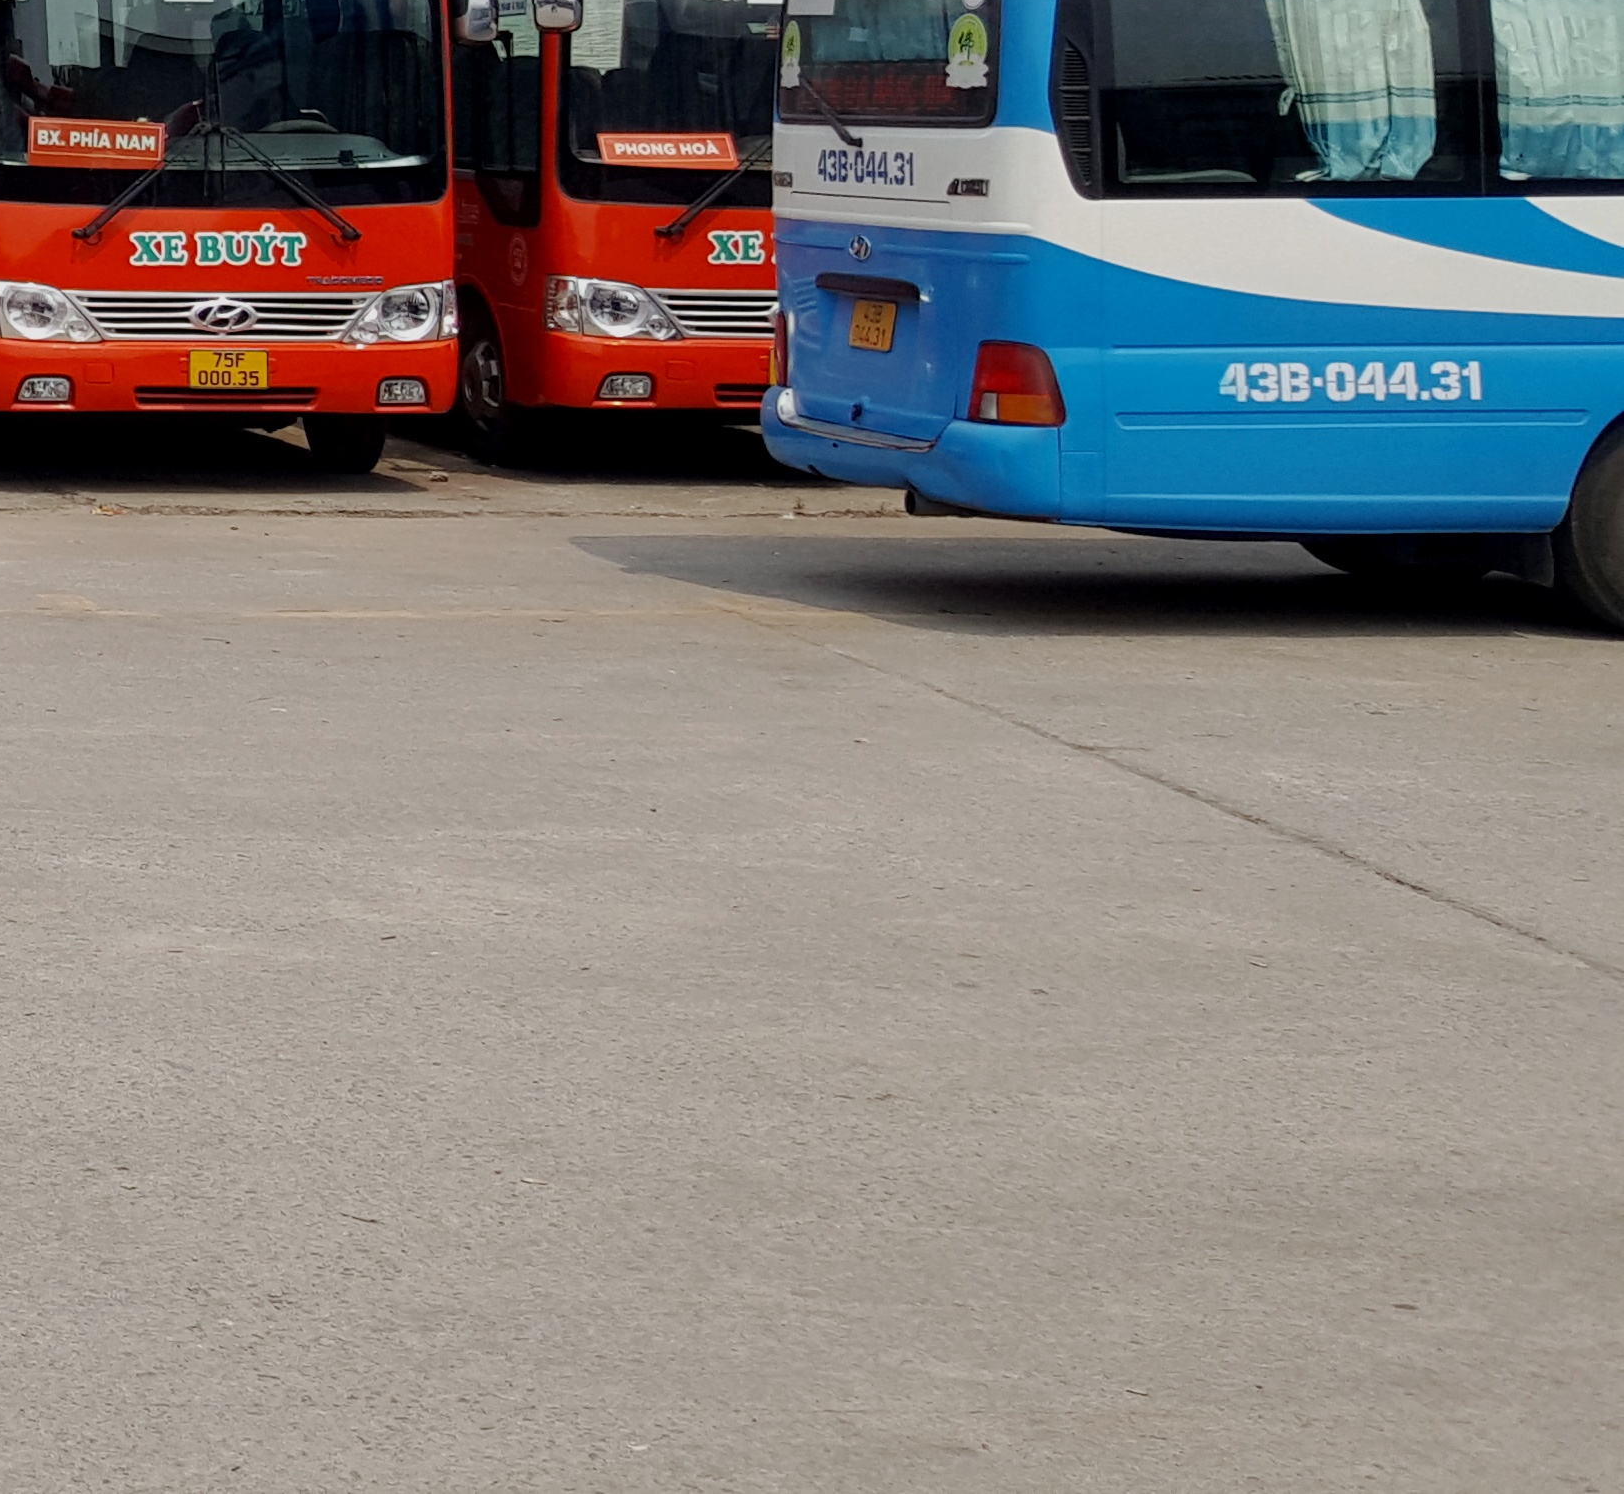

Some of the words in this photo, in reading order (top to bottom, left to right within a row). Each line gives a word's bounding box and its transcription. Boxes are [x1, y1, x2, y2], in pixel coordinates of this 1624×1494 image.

[37, 129, 66, 146] BX.
[69, 128, 111, 149] PHÍA
[115, 134, 156, 151] NAM
[614, 142, 677, 156] PHONG
[679, 140, 720, 155] HOÀ
[130, 231, 188, 266] XE
[194, 223, 307, 266] BUÝT
[708, 230, 765, 265] XE
[212, 352, 245, 368] 75F
[198, 370, 260, 386] 000.35
